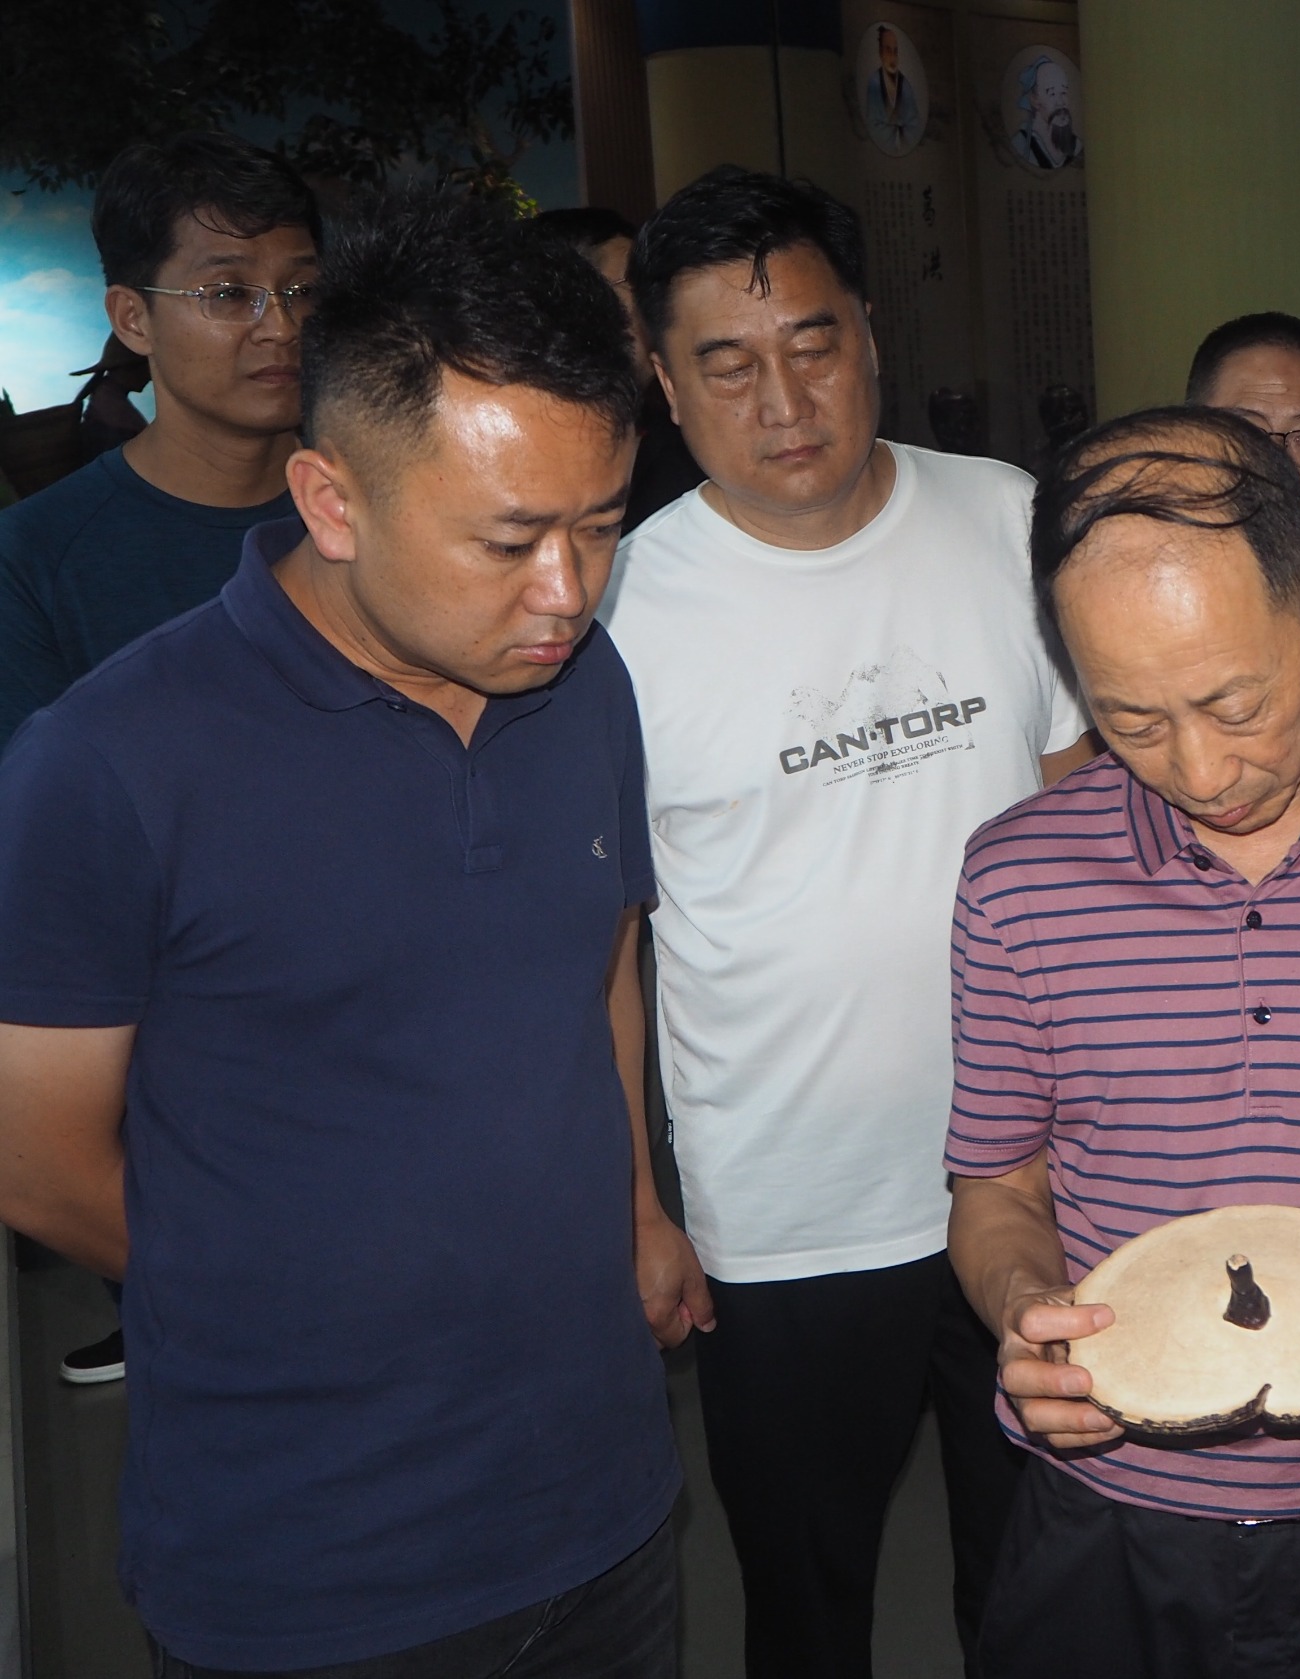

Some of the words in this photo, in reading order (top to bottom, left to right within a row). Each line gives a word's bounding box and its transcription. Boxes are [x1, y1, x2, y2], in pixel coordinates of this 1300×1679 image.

[833, 757, 865, 775] NEVER
[867, 750, 889, 764] STOP
[891, 735, 950, 759] EXPLORING
